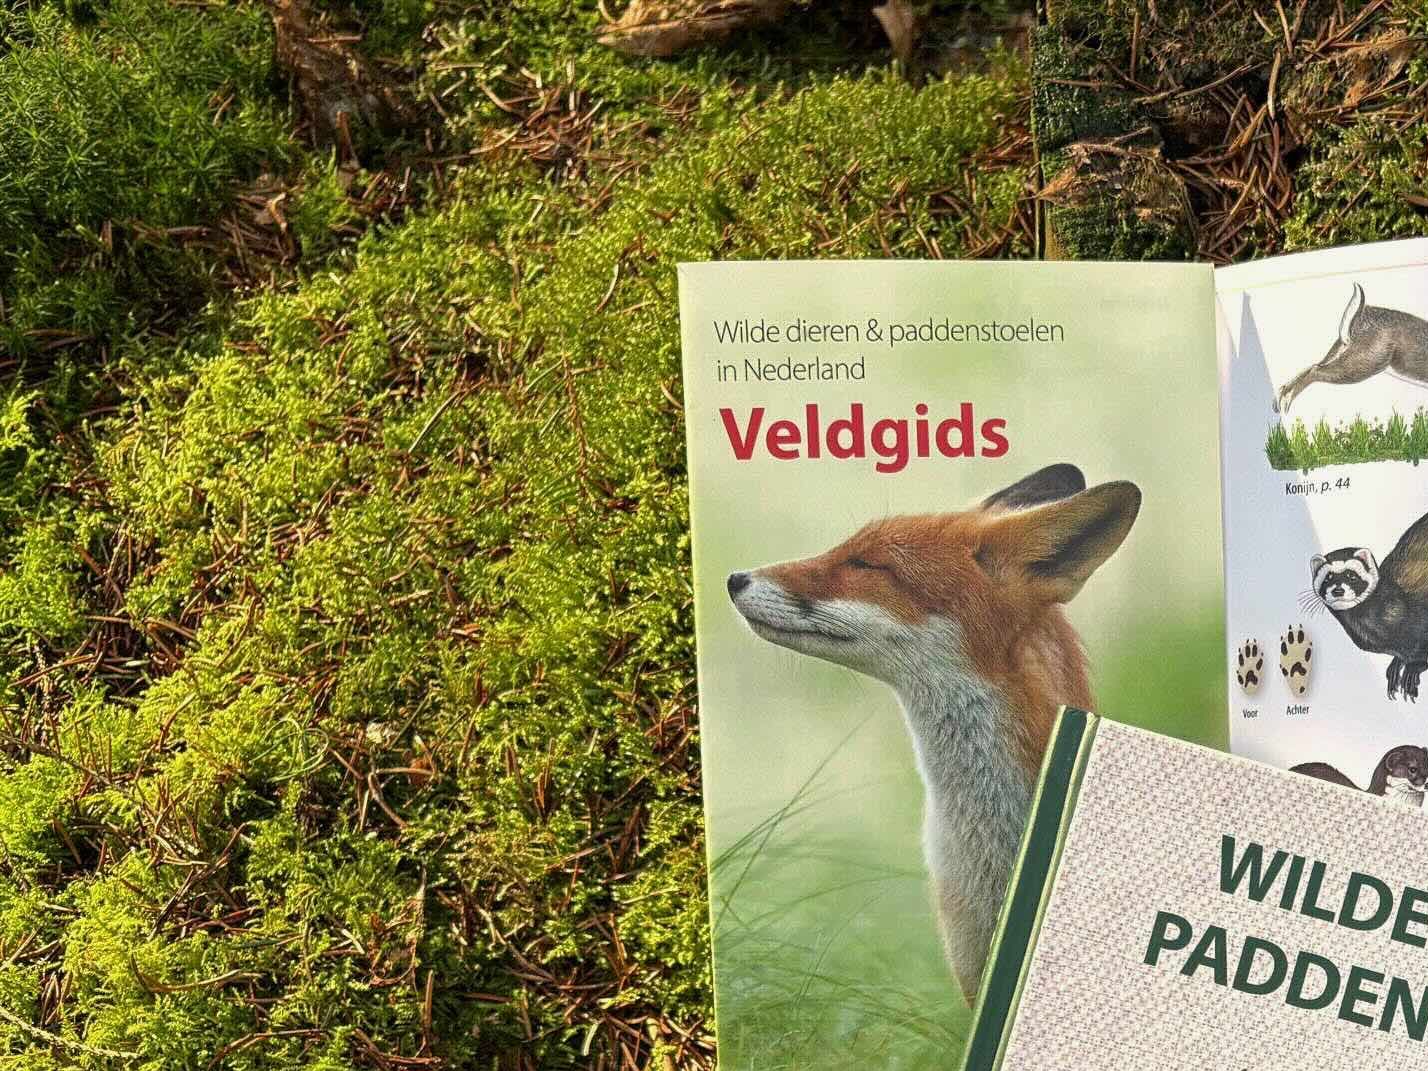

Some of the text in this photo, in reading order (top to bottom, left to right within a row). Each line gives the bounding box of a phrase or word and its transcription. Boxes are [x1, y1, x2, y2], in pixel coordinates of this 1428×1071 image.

[713, 318, 1064, 347] Wilde dieren & paddenstoelen
[716, 357, 866, 382] in Nederland
[719, 402, 1010, 473] Veldgids
[1285, 477, 1351, 496] Konijn, p. 44
[1242, 708, 1258, 719] Voor
[1286, 704, 1310, 716] Achter
